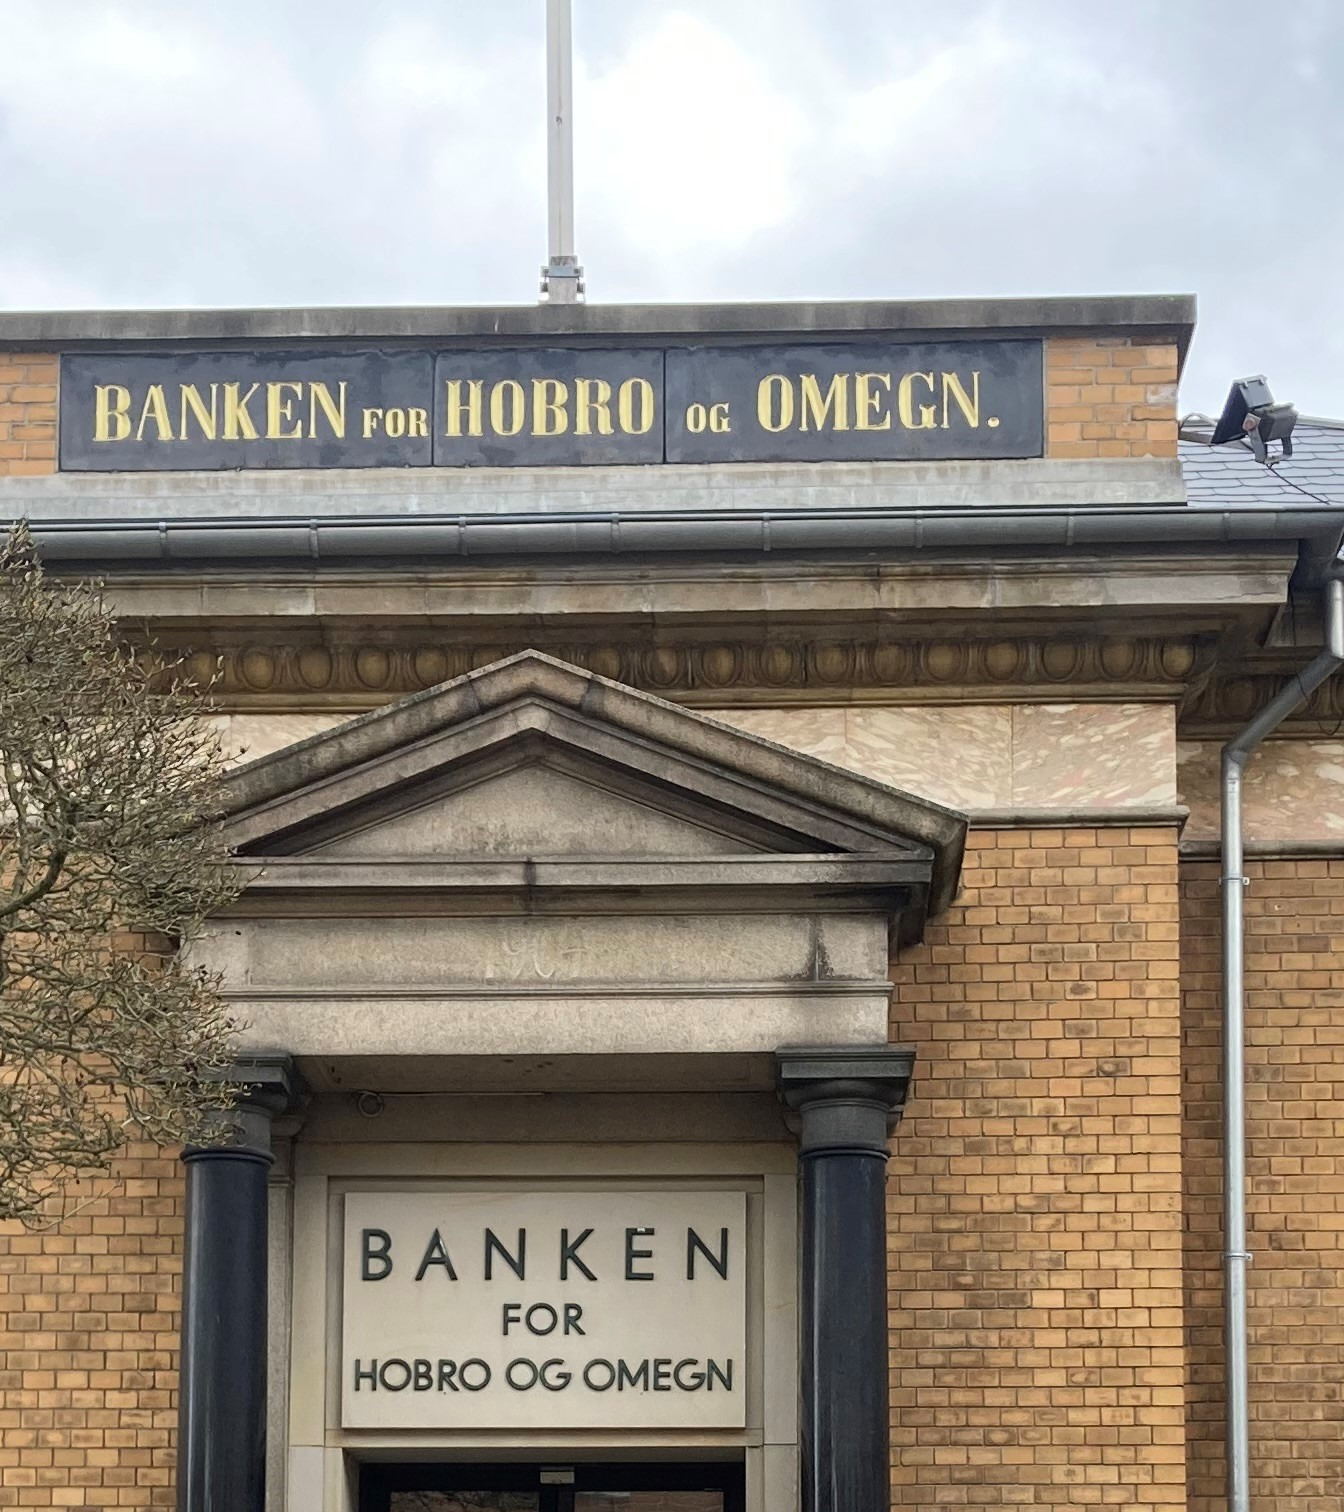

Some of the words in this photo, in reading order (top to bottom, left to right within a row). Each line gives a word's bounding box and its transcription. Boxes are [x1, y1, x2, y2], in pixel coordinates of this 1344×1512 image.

[93, 381, 347, 442] BANKEN
[362, 407, 429, 438] FOR
[446, 378, 655, 438] HOBRO
[685, 402, 731, 434] OG
[756, 371, 1000, 432] OMEGN.
[360, 1226, 729, 1282] BANKEN
[502, 1302, 586, 1337] FOR
[354, 1358, 492, 1392] HOBRO
[505, 1358, 572, 1392] OG
[583, 1358, 733, 1392] OMEGN
